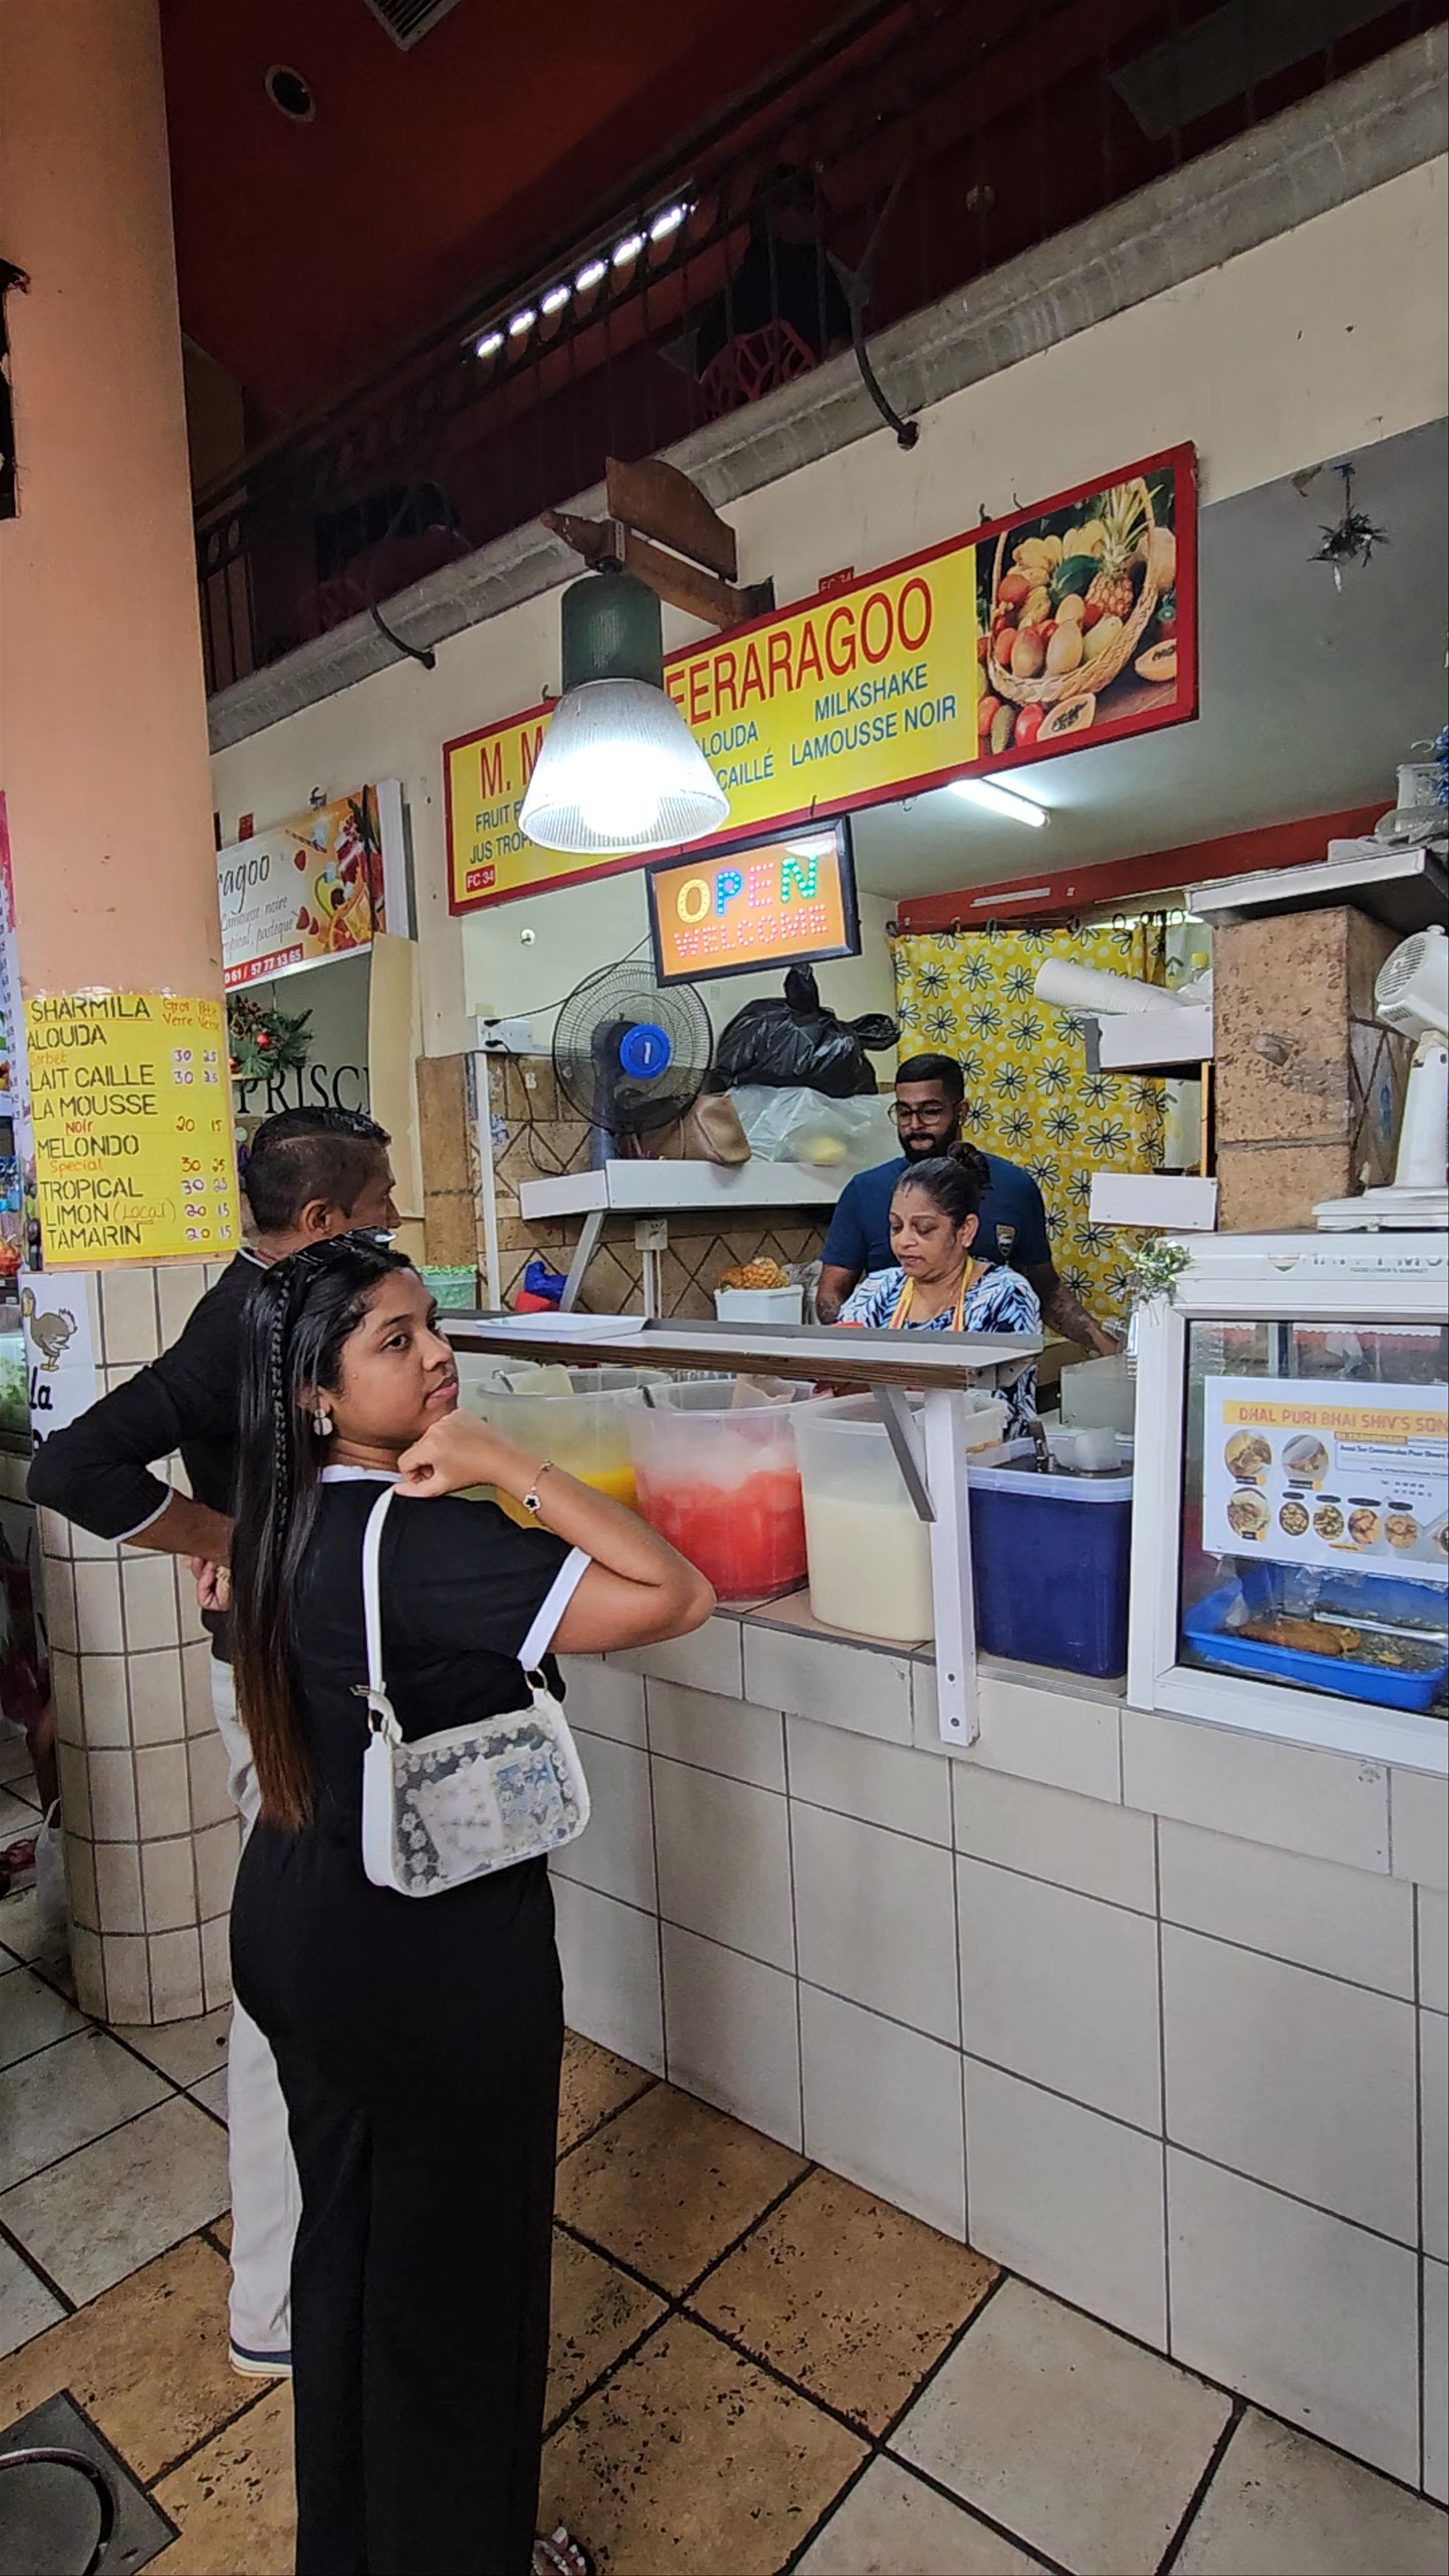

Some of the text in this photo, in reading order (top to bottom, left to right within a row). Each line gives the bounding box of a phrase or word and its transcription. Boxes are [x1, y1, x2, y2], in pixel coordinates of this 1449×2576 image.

[475, 804, 510, 832] FRUIT
[695, 721, 758, 758] LOUDA
[815, 663, 928, 722] MILKSHAKE
[470, 841, 492, 864] JUS
[792, 712, 898, 767] LAMOUSSE
[904, 694, 957, 733] NOIR
[480, 741, 511, 800] M.
[467, 869, 494, 888] FC 34
[677, 852, 818, 923] OPEN
[674, 904, 827, 957] WELCOME
[251, 962, 262, 976] 57
[277, 953, 288, 966] 13
[31, 996, 150, 1022] SHARMILA
[27, 1024, 107, 1052] ALOUDA
[174, 1049, 192, 1063] 30
[29, 1067, 70, 1092] LAIT
[74, 1063, 156, 1088] CAILLE
[174, 1071, 194, 1084] 30
[31, 1094, 159, 1121] LA MOUSSE
[175, 1115, 195, 1132] 20
[211, 1119, 222, 1132] 15
[37, 1134, 140, 1160] MELONDO
[182, 1156, 201, 1173] 30
[40, 1177, 143, 1202] TROPICAL
[181, 1178, 205, 1195] 30
[45, 1202, 109, 1226] LIMON
[185, 1204, 207, 1217] 20
[218, 1202, 229, 1218] 15
[46, 1223, 231, 1250] TAMARIN 20 15
[1239, 1407, 1277, 1423] DHAL
[1282, 1409, 1317, 1425] PURI
